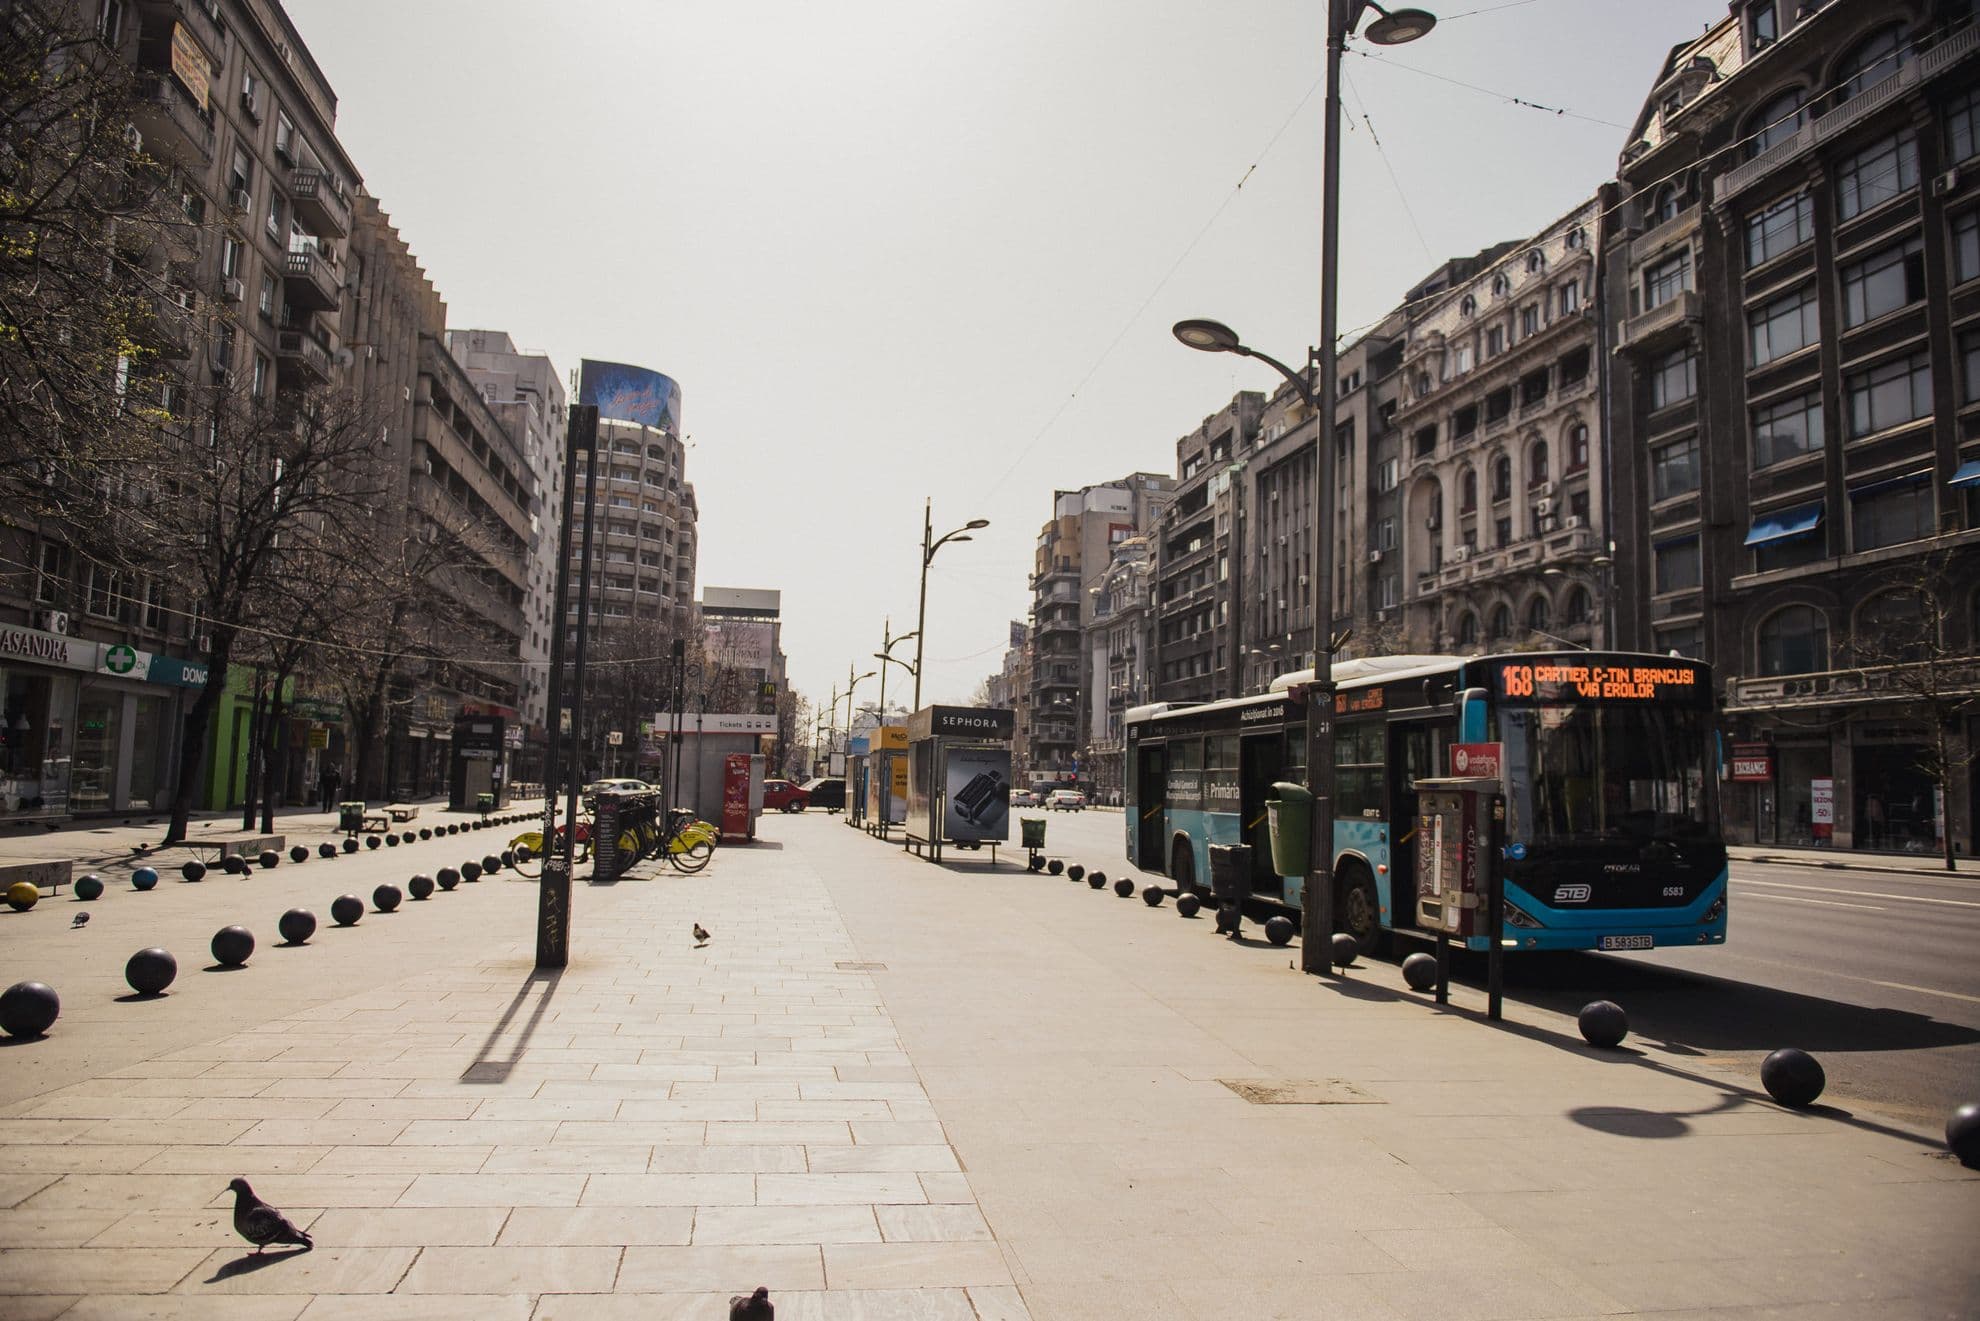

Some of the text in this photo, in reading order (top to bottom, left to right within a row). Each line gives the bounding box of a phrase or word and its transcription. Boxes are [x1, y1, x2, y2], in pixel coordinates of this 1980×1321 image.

[1, 630, 71, 662] ASANDRA
[1503, 666, 1533, 696] 168
[1534, 666, 1694, 685] CARTIER C-TIN BRANCUSI
[1577, 682, 1655, 698] VIA EROILOR
[942, 716, 998, 728] SEPHORA
[1734, 761, 1767, 774] EXCHANGE
[1554, 886, 1590, 901] STB
[1663, 887, 1684, 896] 6583
[1605, 937, 1613, 948] B
